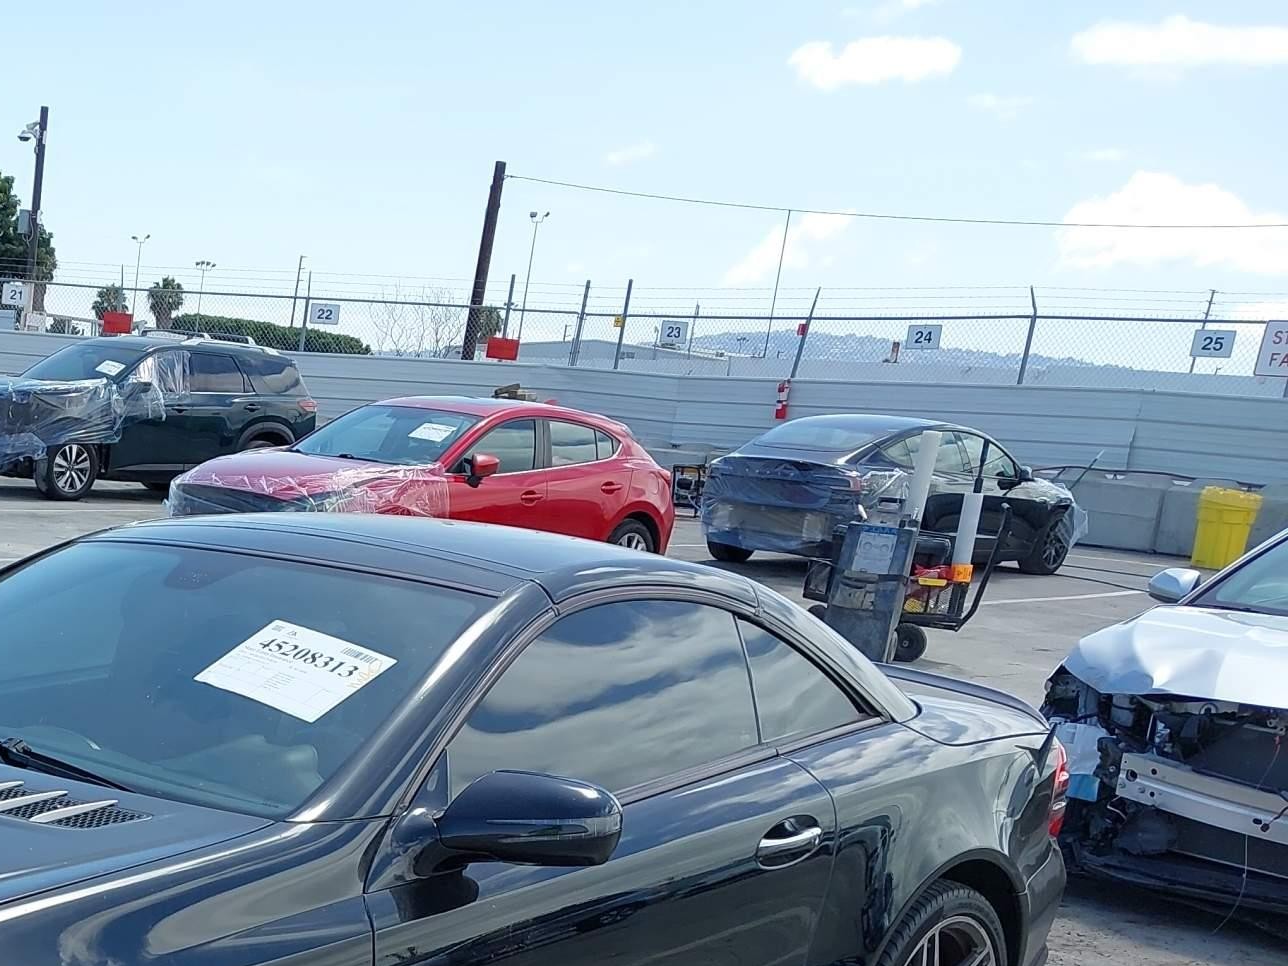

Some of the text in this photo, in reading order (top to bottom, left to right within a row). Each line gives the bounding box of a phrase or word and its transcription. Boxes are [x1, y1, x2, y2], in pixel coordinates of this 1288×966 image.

[9, 289, 23, 301] 21
[316, 308, 333, 320] 22
[667, 326, 681, 338] 23
[914, 330, 933, 344] 24
[1200, 336, 1225, 352] 25
[259, 638, 360, 679] 45208313
